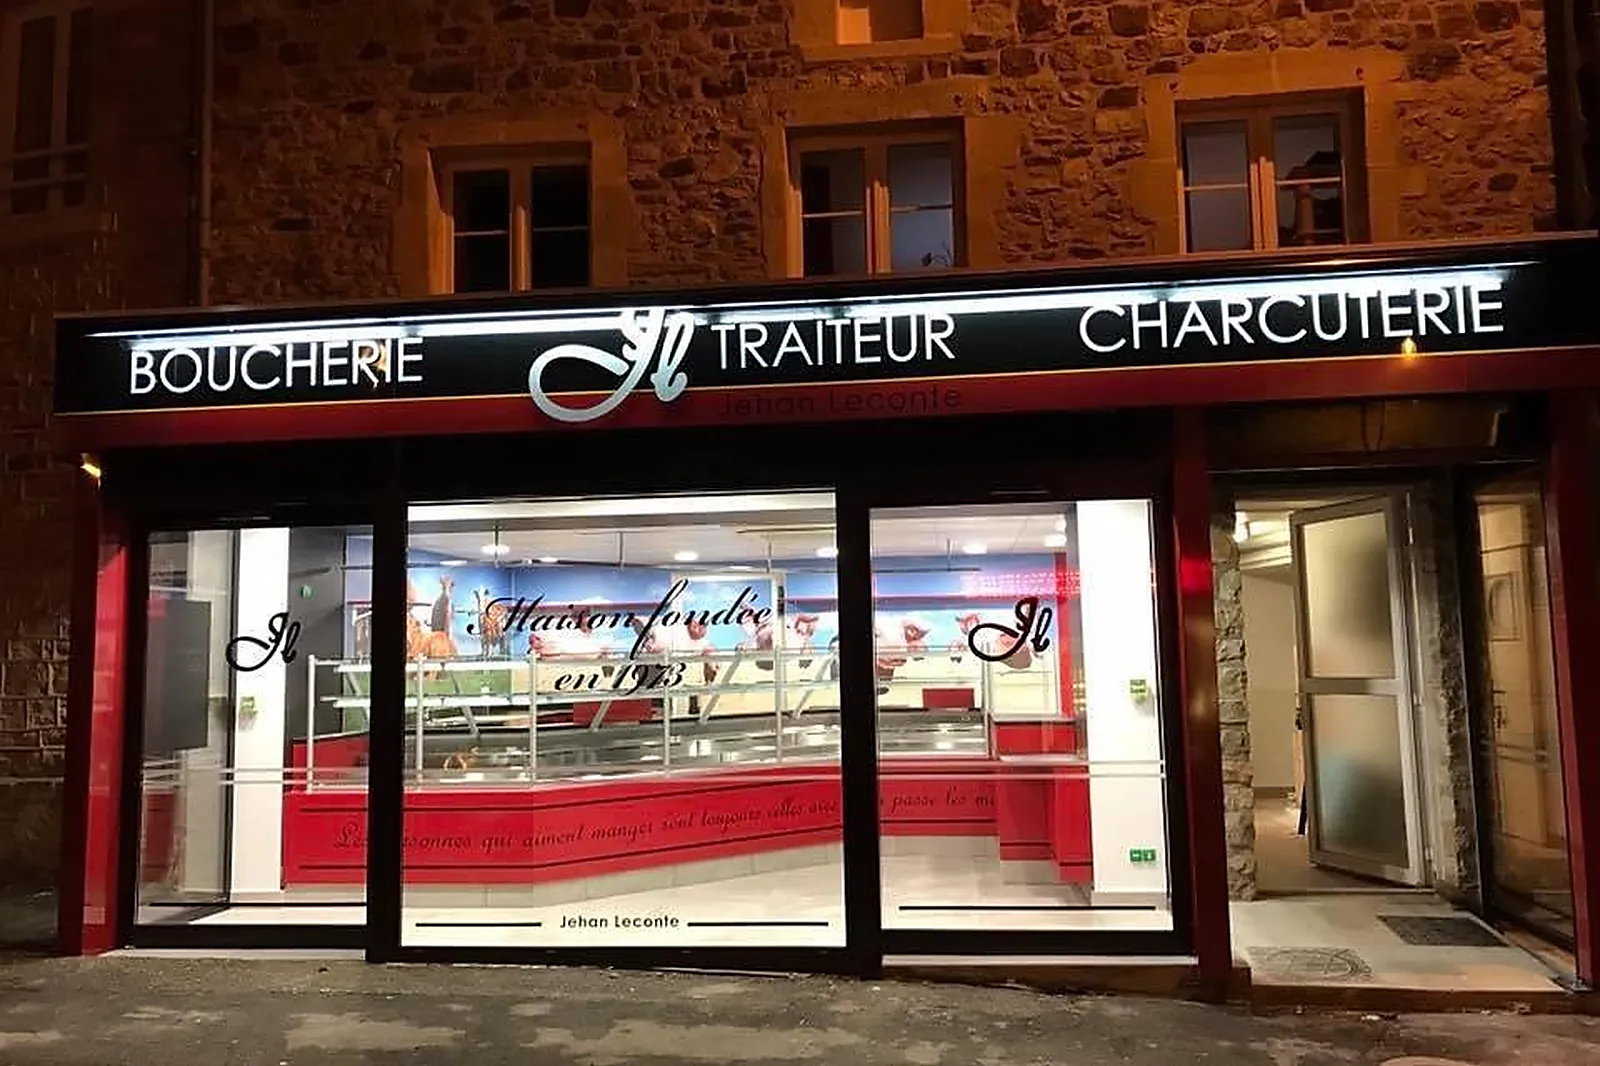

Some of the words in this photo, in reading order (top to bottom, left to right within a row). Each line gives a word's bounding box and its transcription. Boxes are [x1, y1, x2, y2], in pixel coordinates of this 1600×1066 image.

[711, 312, 957, 370] TRAITEUR
[1079, 279, 1505, 353] CHARCUTERIE
[130, 337, 424, 395] BOUCHERIE
[466, 592, 640, 636] Maison
[629, 577, 773, 661] fondée
[554, 671, 601, 691] en
[611, 661, 687, 696] 1973
[560, 914, 608, 929] Jehan
[614, 914, 679, 929] Leconte
